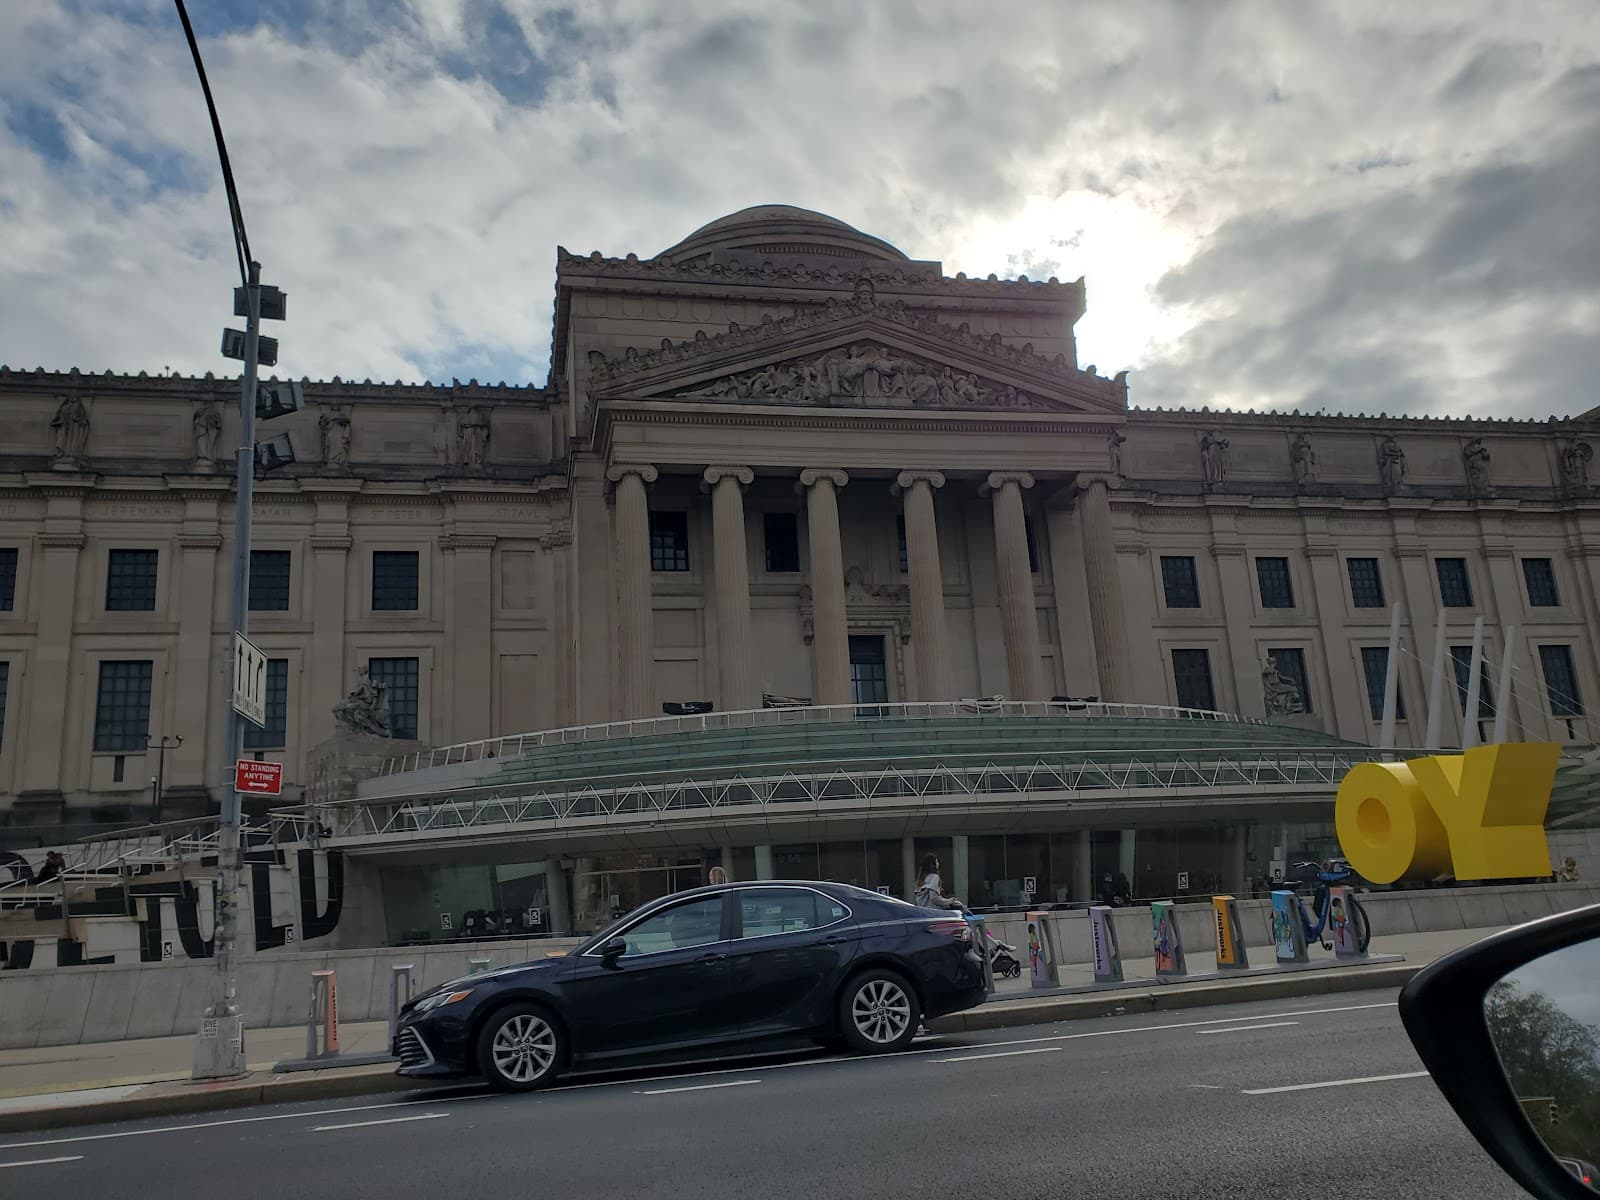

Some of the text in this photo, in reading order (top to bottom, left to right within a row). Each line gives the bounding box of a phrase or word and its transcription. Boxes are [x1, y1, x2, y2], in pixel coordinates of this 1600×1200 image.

[240, 763, 279, 773] NO STANDING
[243, 772, 275, 781] ANYTIME
[1335, 743, 1561, 884] OY
